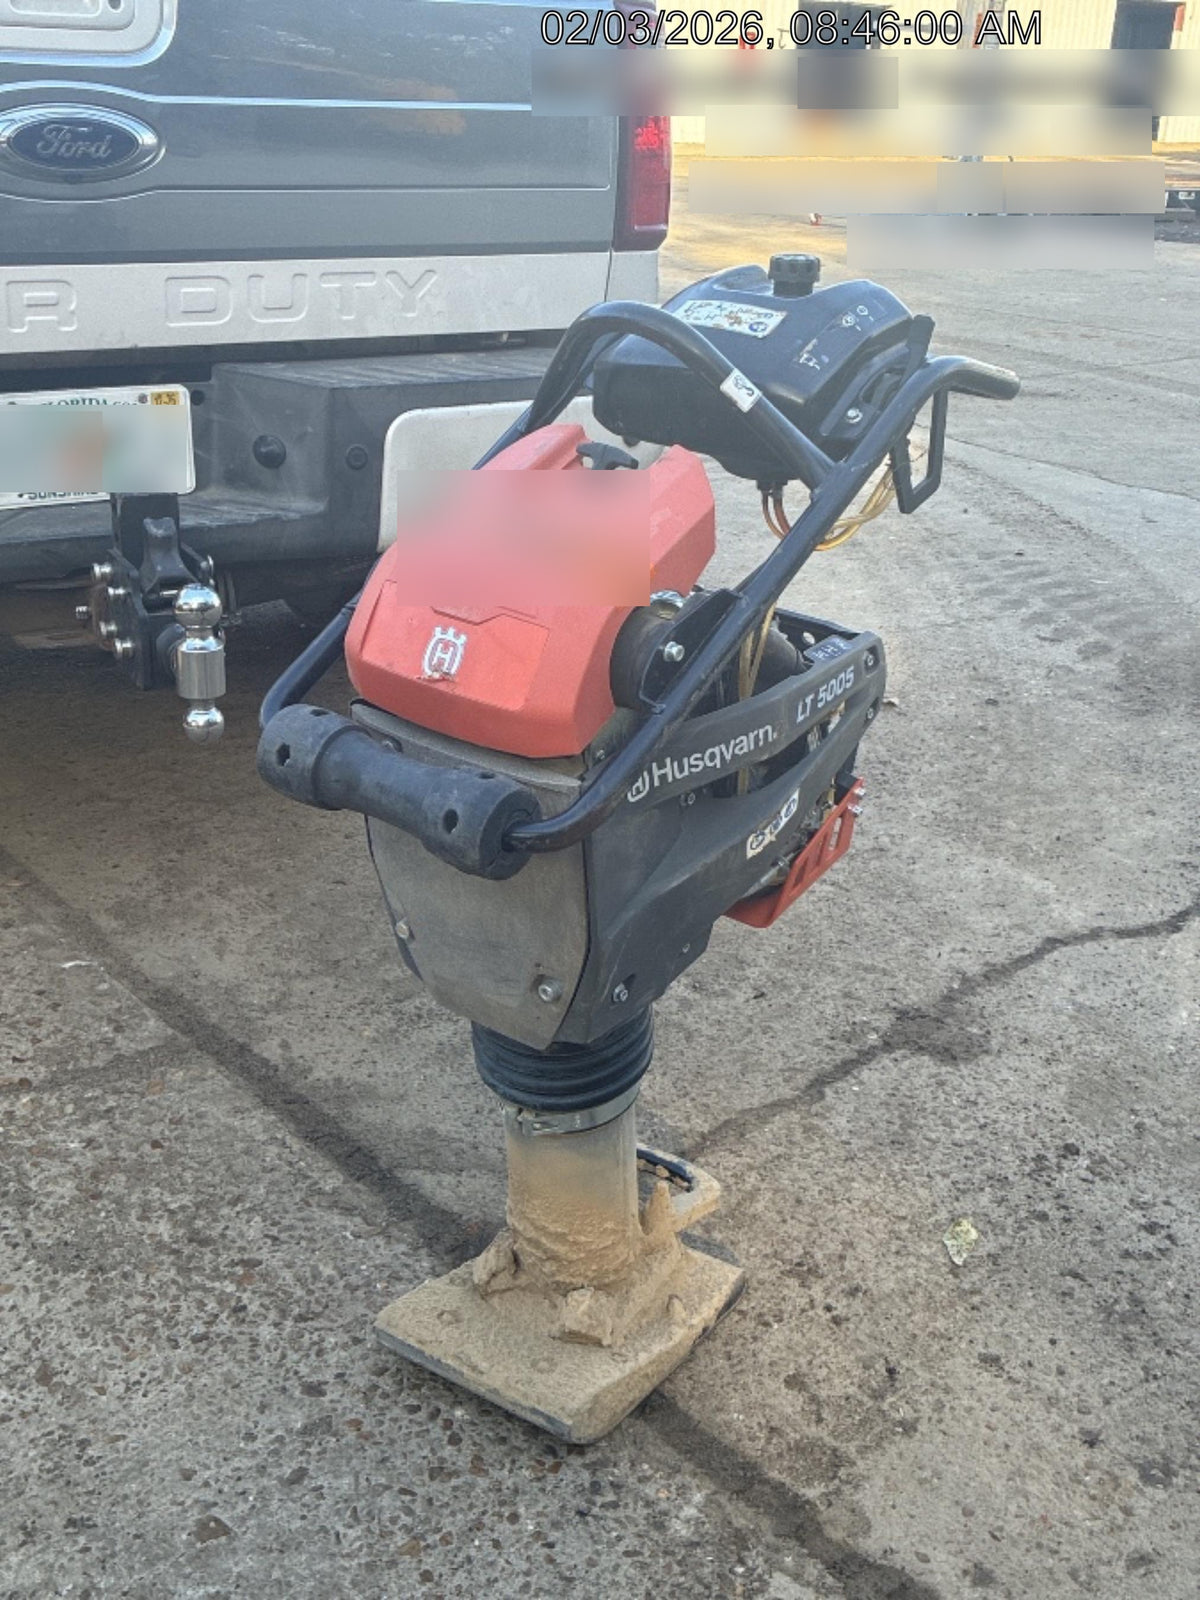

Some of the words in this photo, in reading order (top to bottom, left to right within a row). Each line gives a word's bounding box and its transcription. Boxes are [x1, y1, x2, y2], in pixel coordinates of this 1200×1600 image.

[37, 124, 112, 158] Ford
[165, 269, 438, 327] DUTY
[796, 693, 815, 725] LT
[817, 665, 855, 709] 5005
